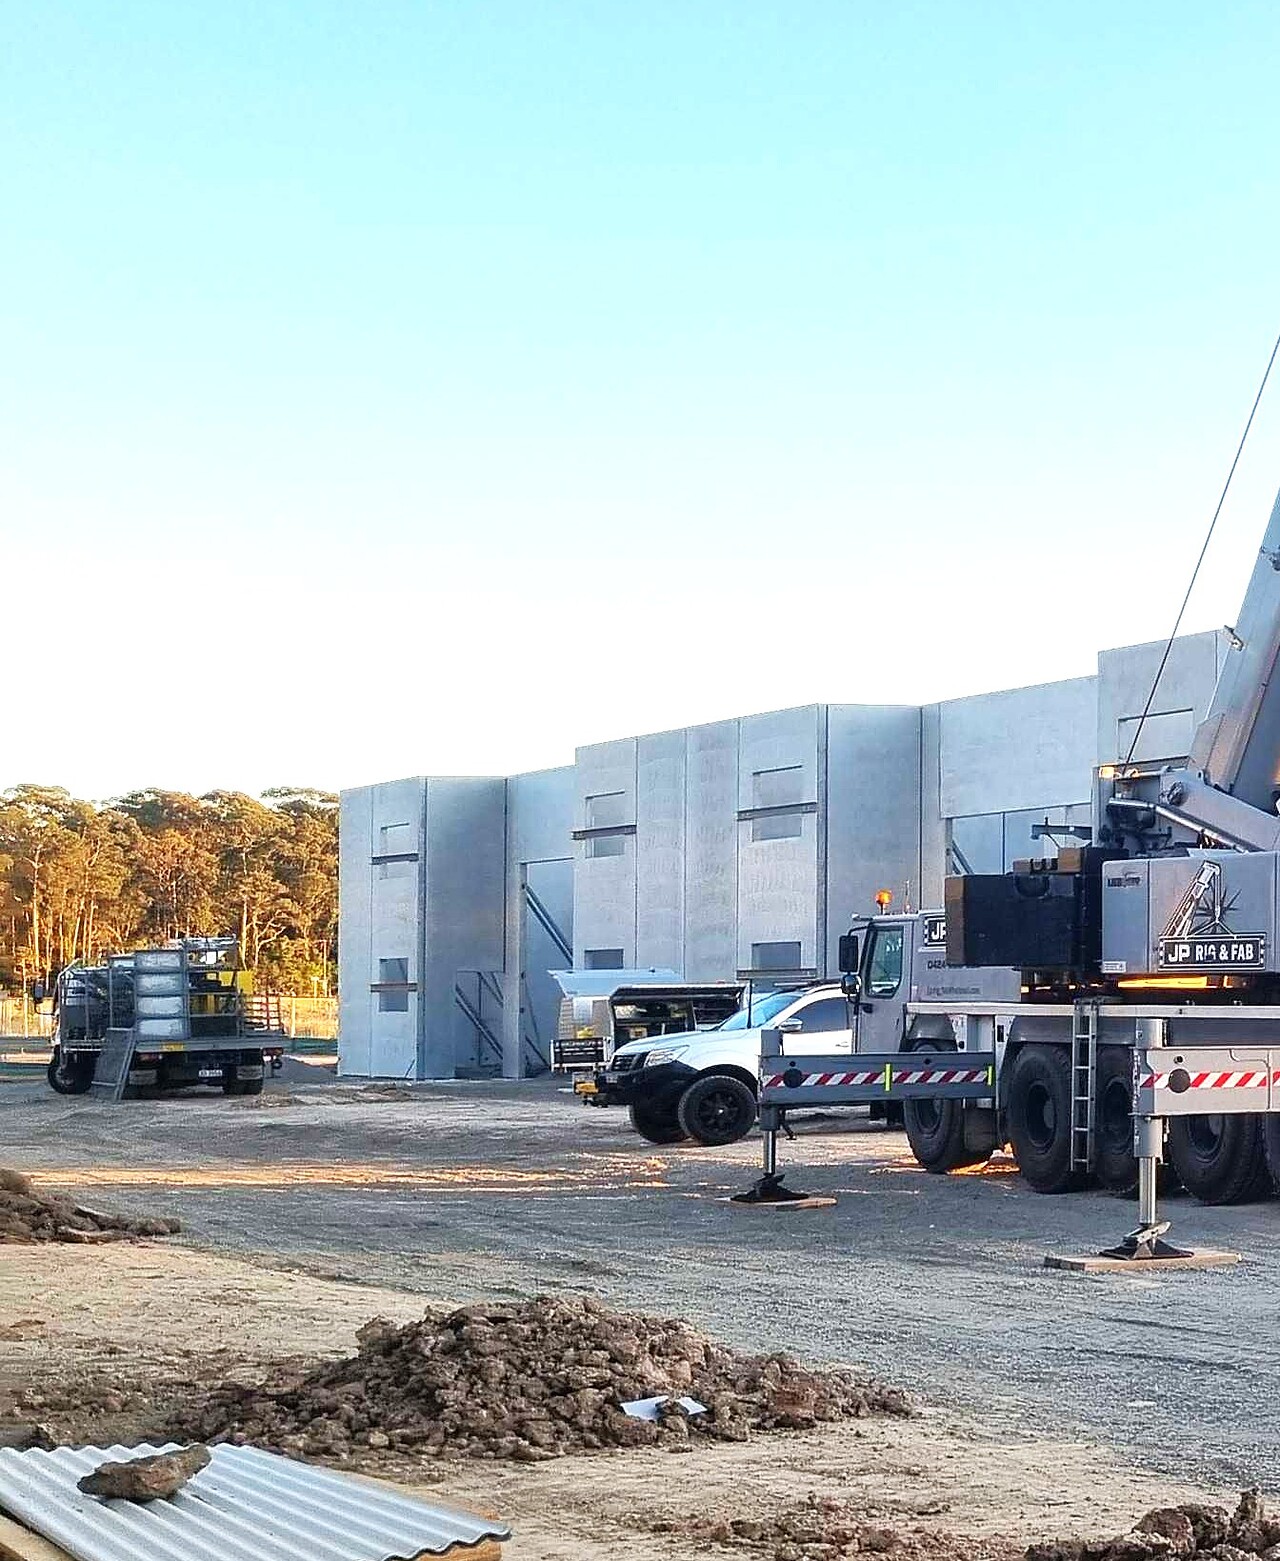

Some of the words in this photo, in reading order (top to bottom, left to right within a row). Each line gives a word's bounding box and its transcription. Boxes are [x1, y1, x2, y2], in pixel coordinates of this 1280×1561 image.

[1168, 944, 1191, 963] JP
[1219, 943, 1229, 961] &
[1231, 943, 1254, 961] FAB
